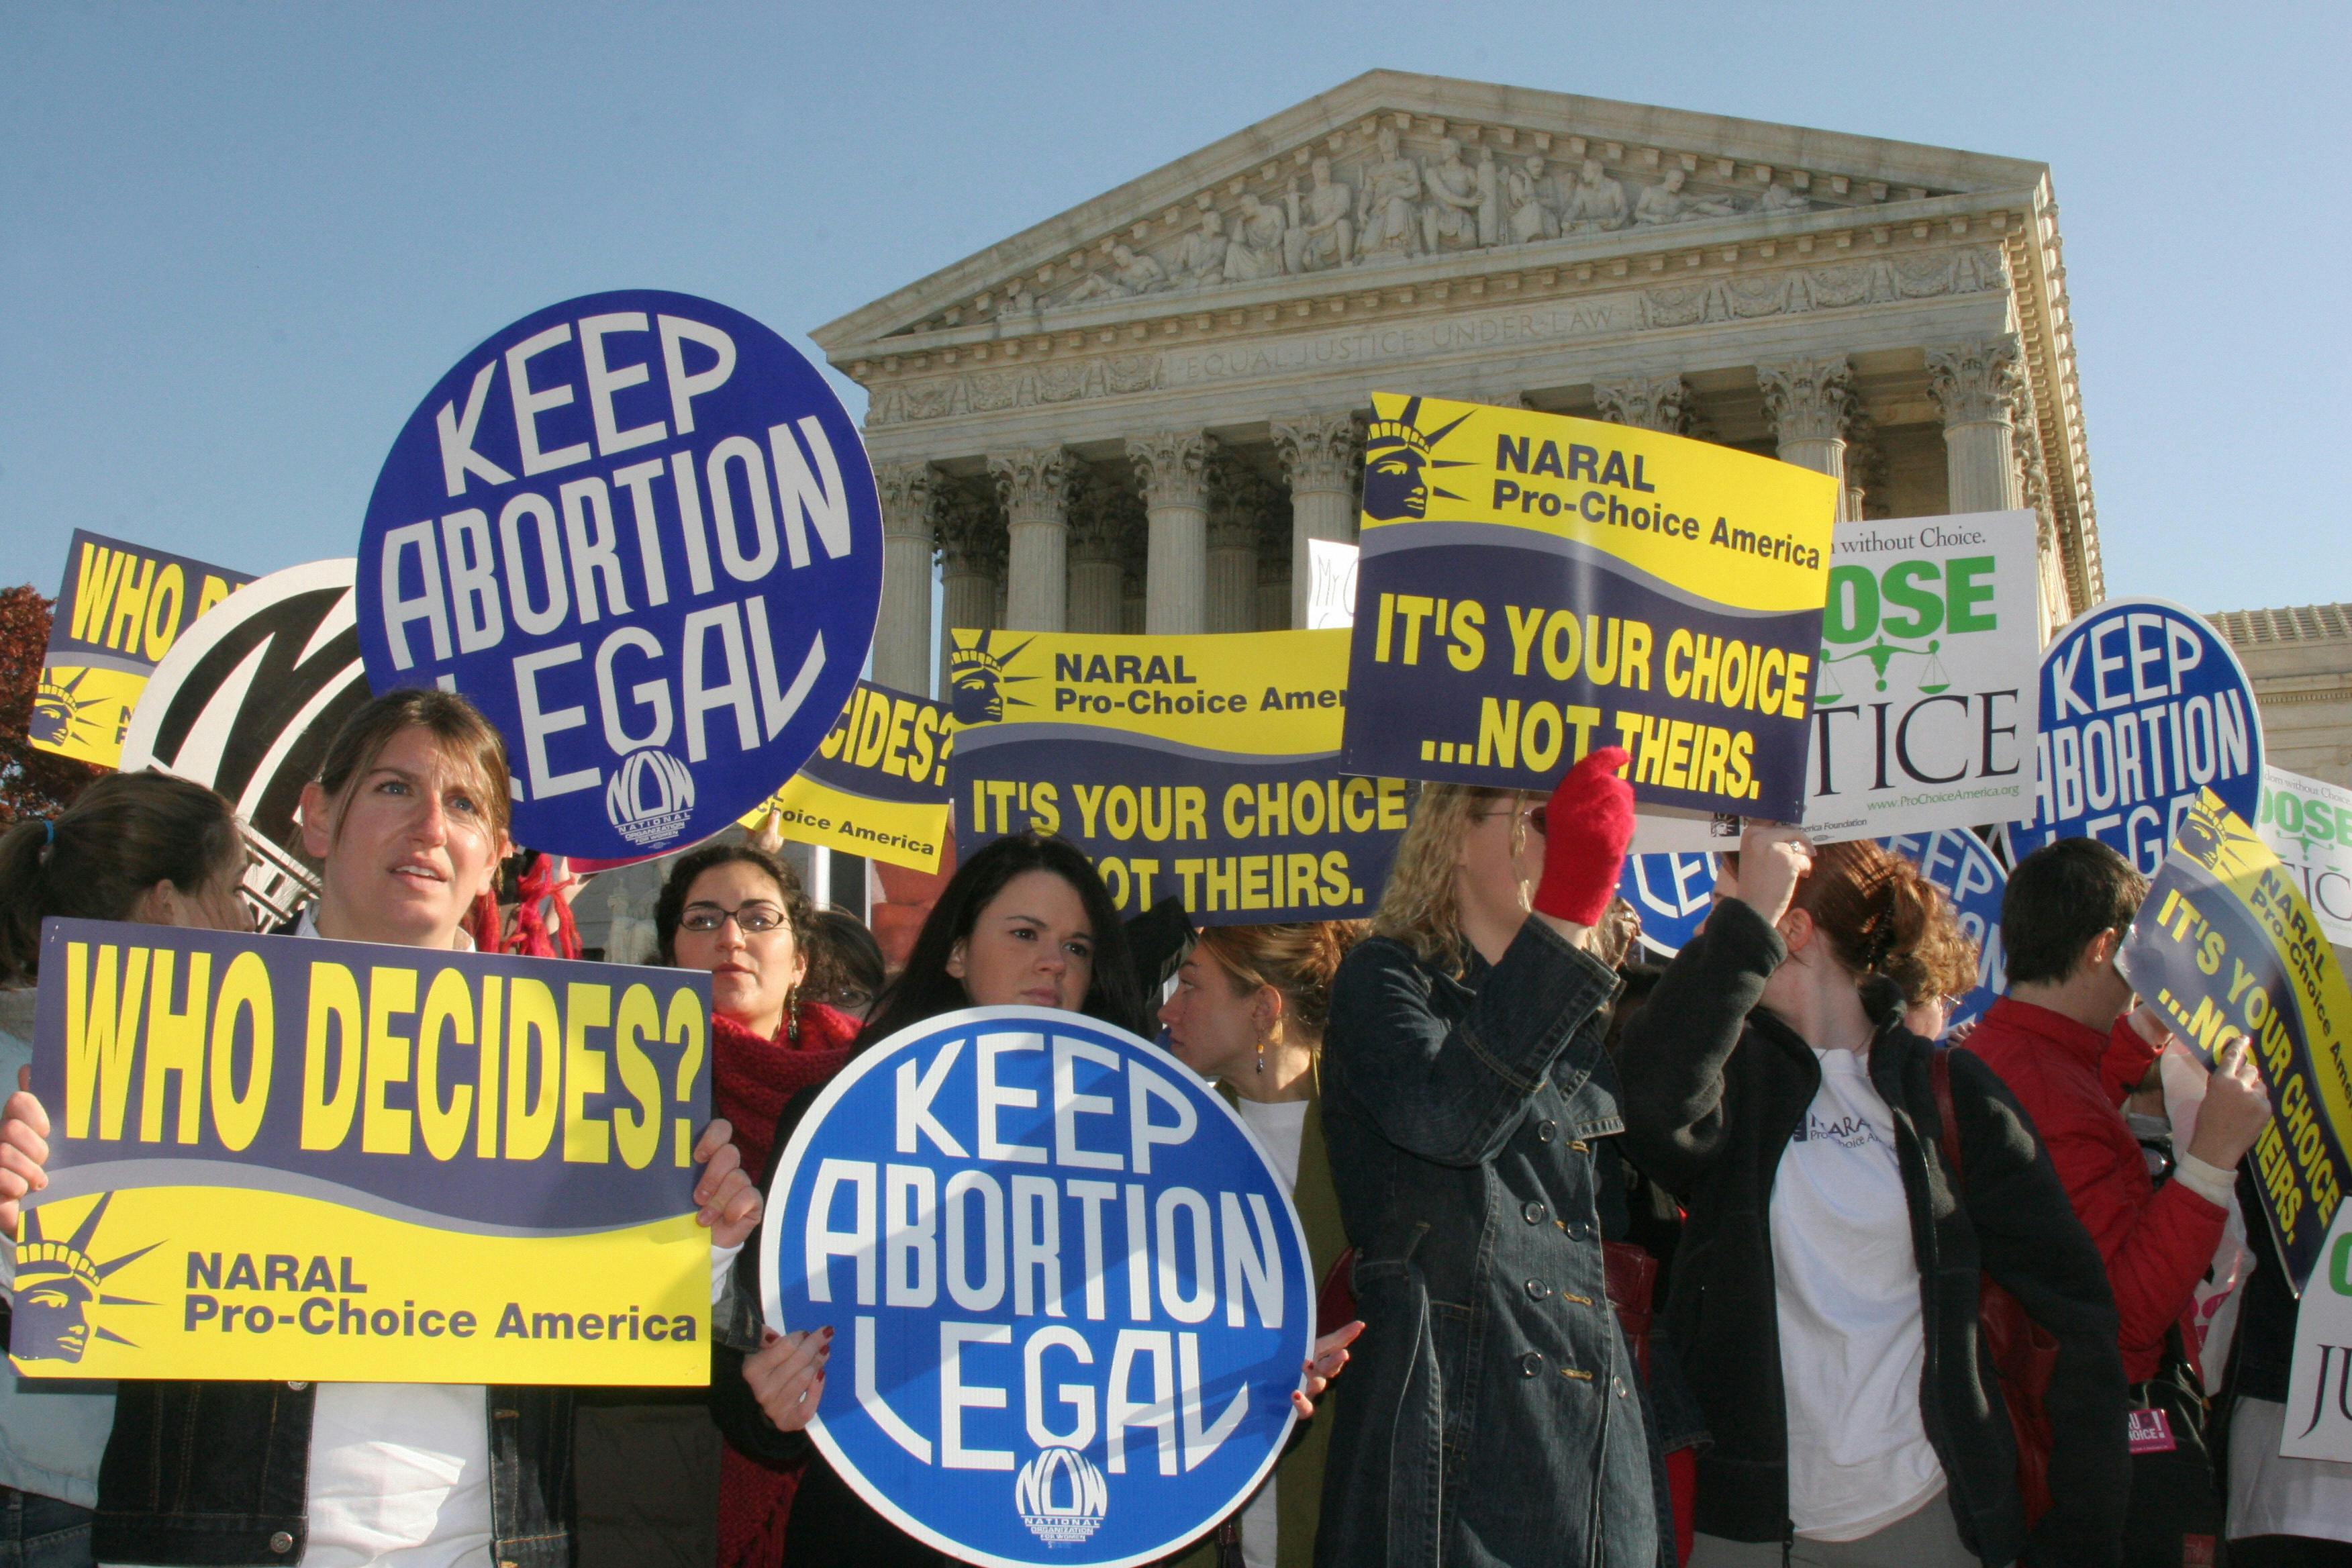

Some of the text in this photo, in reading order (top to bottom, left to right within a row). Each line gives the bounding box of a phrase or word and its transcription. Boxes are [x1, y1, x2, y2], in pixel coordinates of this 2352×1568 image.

[1186, 305, 1613, 379] EQUAL JUSTICE UNDER LAW
[436, 312, 737, 497] KEEP
[1496, 434, 1655, 493] NARAL
[381, 415, 851, 671] ABORTION
[1492, 479, 1820, 570] Pro-Choice America
[1841, 532, 1914, 554] without
[1920, 526, 1986, 548] Choice.
[70, 542, 184, 661] WHO
[1822, 555, 1997, 644] OSE
[1055, 653, 1195, 684] NARAL
[1375, 593, 1810, 720] IT'S YOUR CHOICE
[2053, 613, 2202, 721] KEEP
[1056, 687, 1246, 714] Pro-Choice
[1421, 697, 1760, 799] ...NOT THEIRS.
[1813, 689, 2020, 796] TICE
[2022, 688, 2249, 830] ABORTION
[607, 750, 695, 825] NOW
[618, 812, 690, 833] NATIONAL
[973, 774, 1406, 840] IT'S YOUR CHOICE
[1824, 818, 1867, 830] Foundation
[1867, 785, 2020, 812] www.ProChoiceAmerica.org
[625, 822, 685, 838] ORGANIZATION
[838, 821, 934, 856] America
[1085, 852, 1362, 914] OT THEIRS.
[2259, 868, 2325, 983] NARAL
[2250, 887, 2352, 1109] Pro-Choice Ame
[66, 942, 705, 1169] WHO DECIDES?
[2157, 889, 2340, 1230] IT'S YOUR CHOICE
[896, 1032, 1197, 1174] KEEP
[186, 1251, 367, 1294] NARAL
[806, 1159, 1284, 1328] ABORTION
[183, 1294, 697, 1342] Pro-Choice America
[854, 1316, 1248, 1475] LEGAL
[1016, 1449, 1107, 1516] NOW
[1025, 1518, 1099, 1528] NATIONAL
